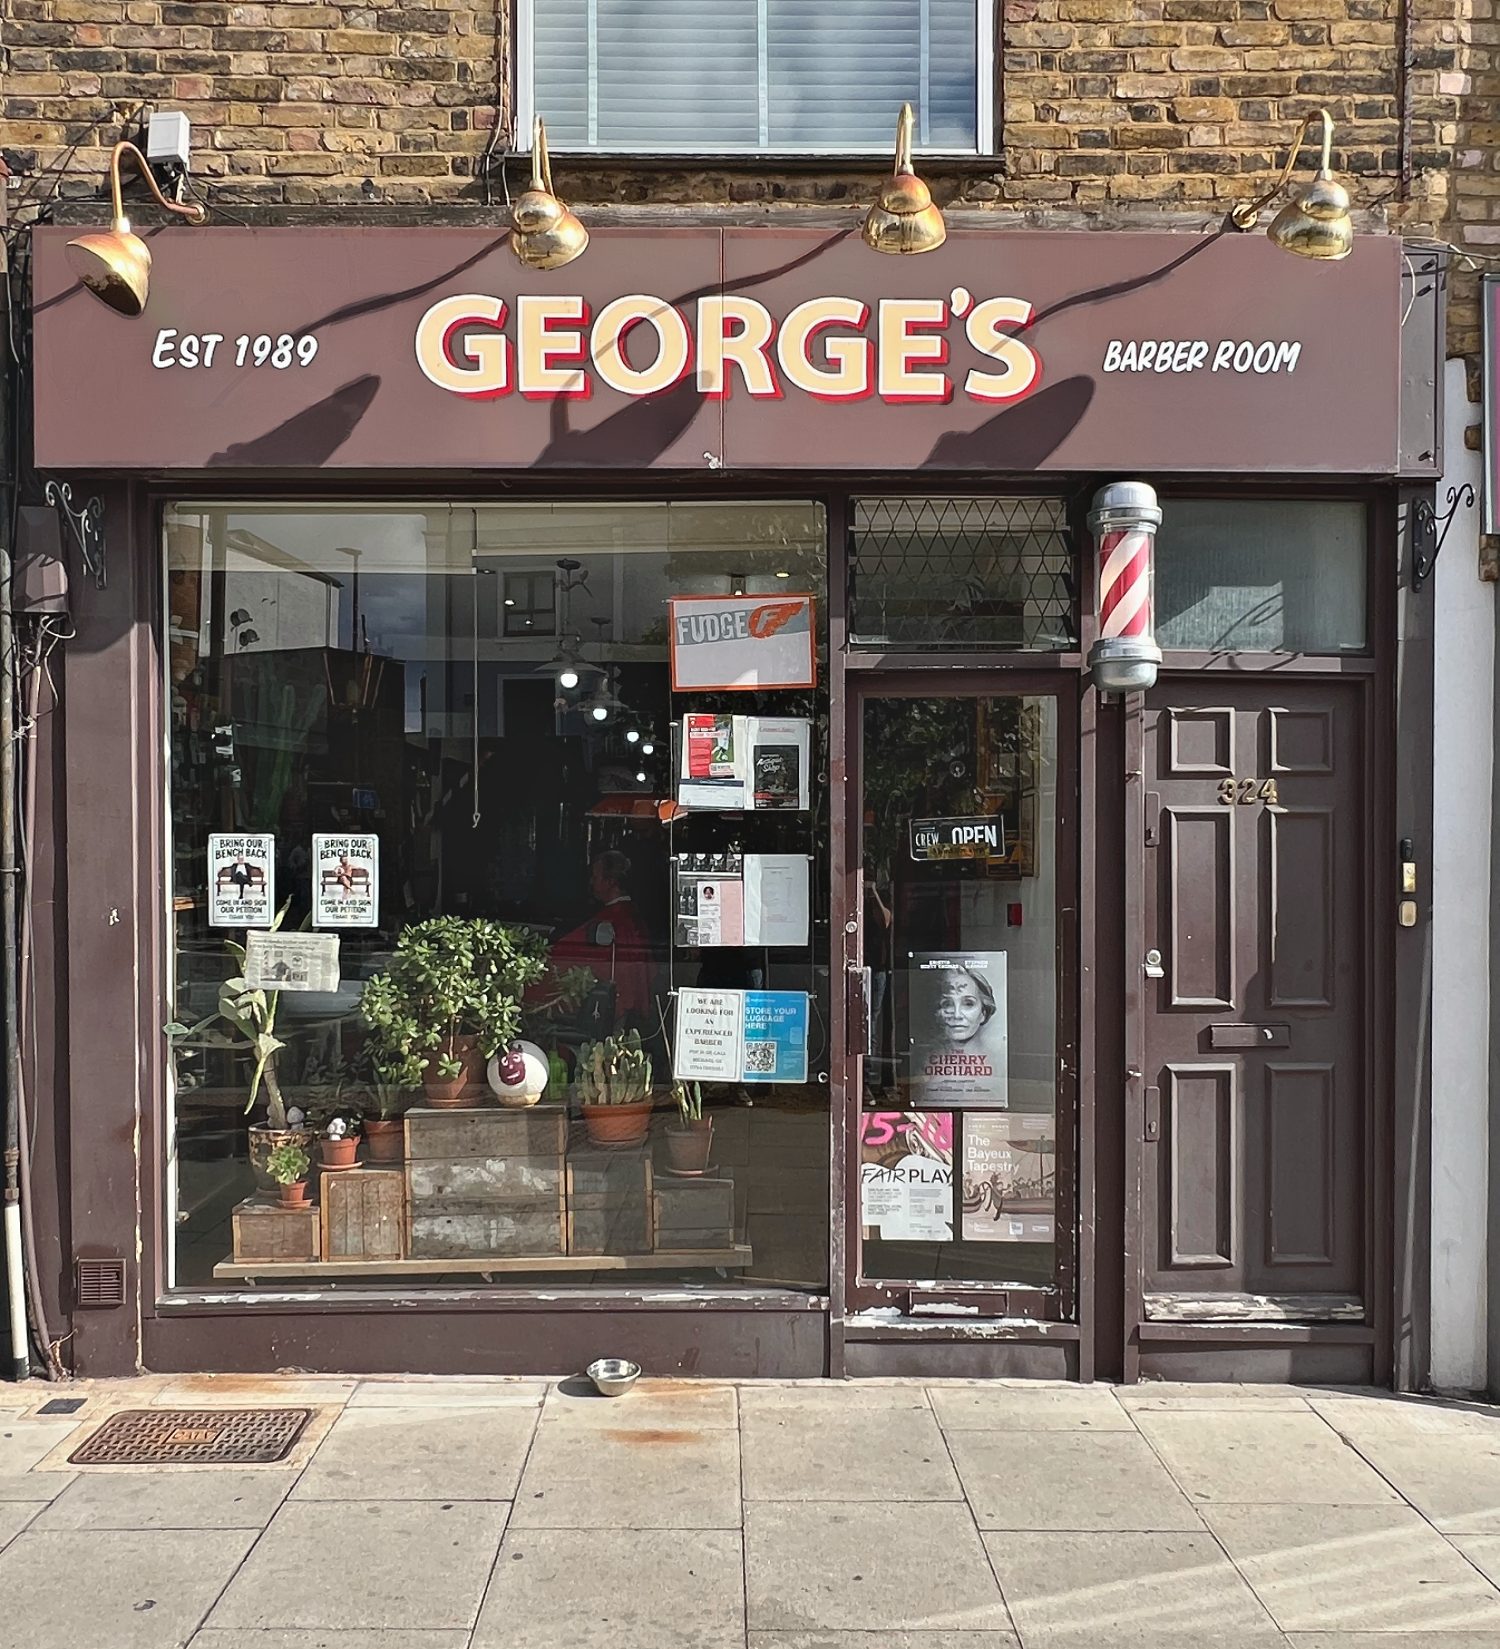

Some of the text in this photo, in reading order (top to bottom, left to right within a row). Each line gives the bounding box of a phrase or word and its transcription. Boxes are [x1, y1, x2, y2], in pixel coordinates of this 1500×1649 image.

[152, 328, 319, 369] EST 1989
[414, 287, 1043, 404] GEORGE'S
[1102, 339, 1302, 374] BARBER ROOM
[676, 611, 749, 645] FUDGE
[1217, 778, 1278, 806] 324
[951, 825, 998, 847] OPEN
[220, 839, 263, 848] BRING OUR
[324, 839, 368, 849] BRING OUR
[215, 848, 268, 860] BENCH BACK
[320, 848, 373, 860] BENCH BACK
[686, 1008, 718, 1016] LOOKING
[745, 1006, 798, 1016] STORE YOUR
[745, 1014, 785, 1023] LUGGAGE
[745, 1022, 767, 1030] HERE
[685, 1028, 733, 1037] EXPERIENCED
[929, 1054, 988, 1065] CHERRY
[924, 1065, 993, 1077] ORCHARD
[966, 1134, 991, 1146] The
[967, 1147, 1013, 1162] Bayeux
[967, 1159, 1020, 1175] Tapestry
